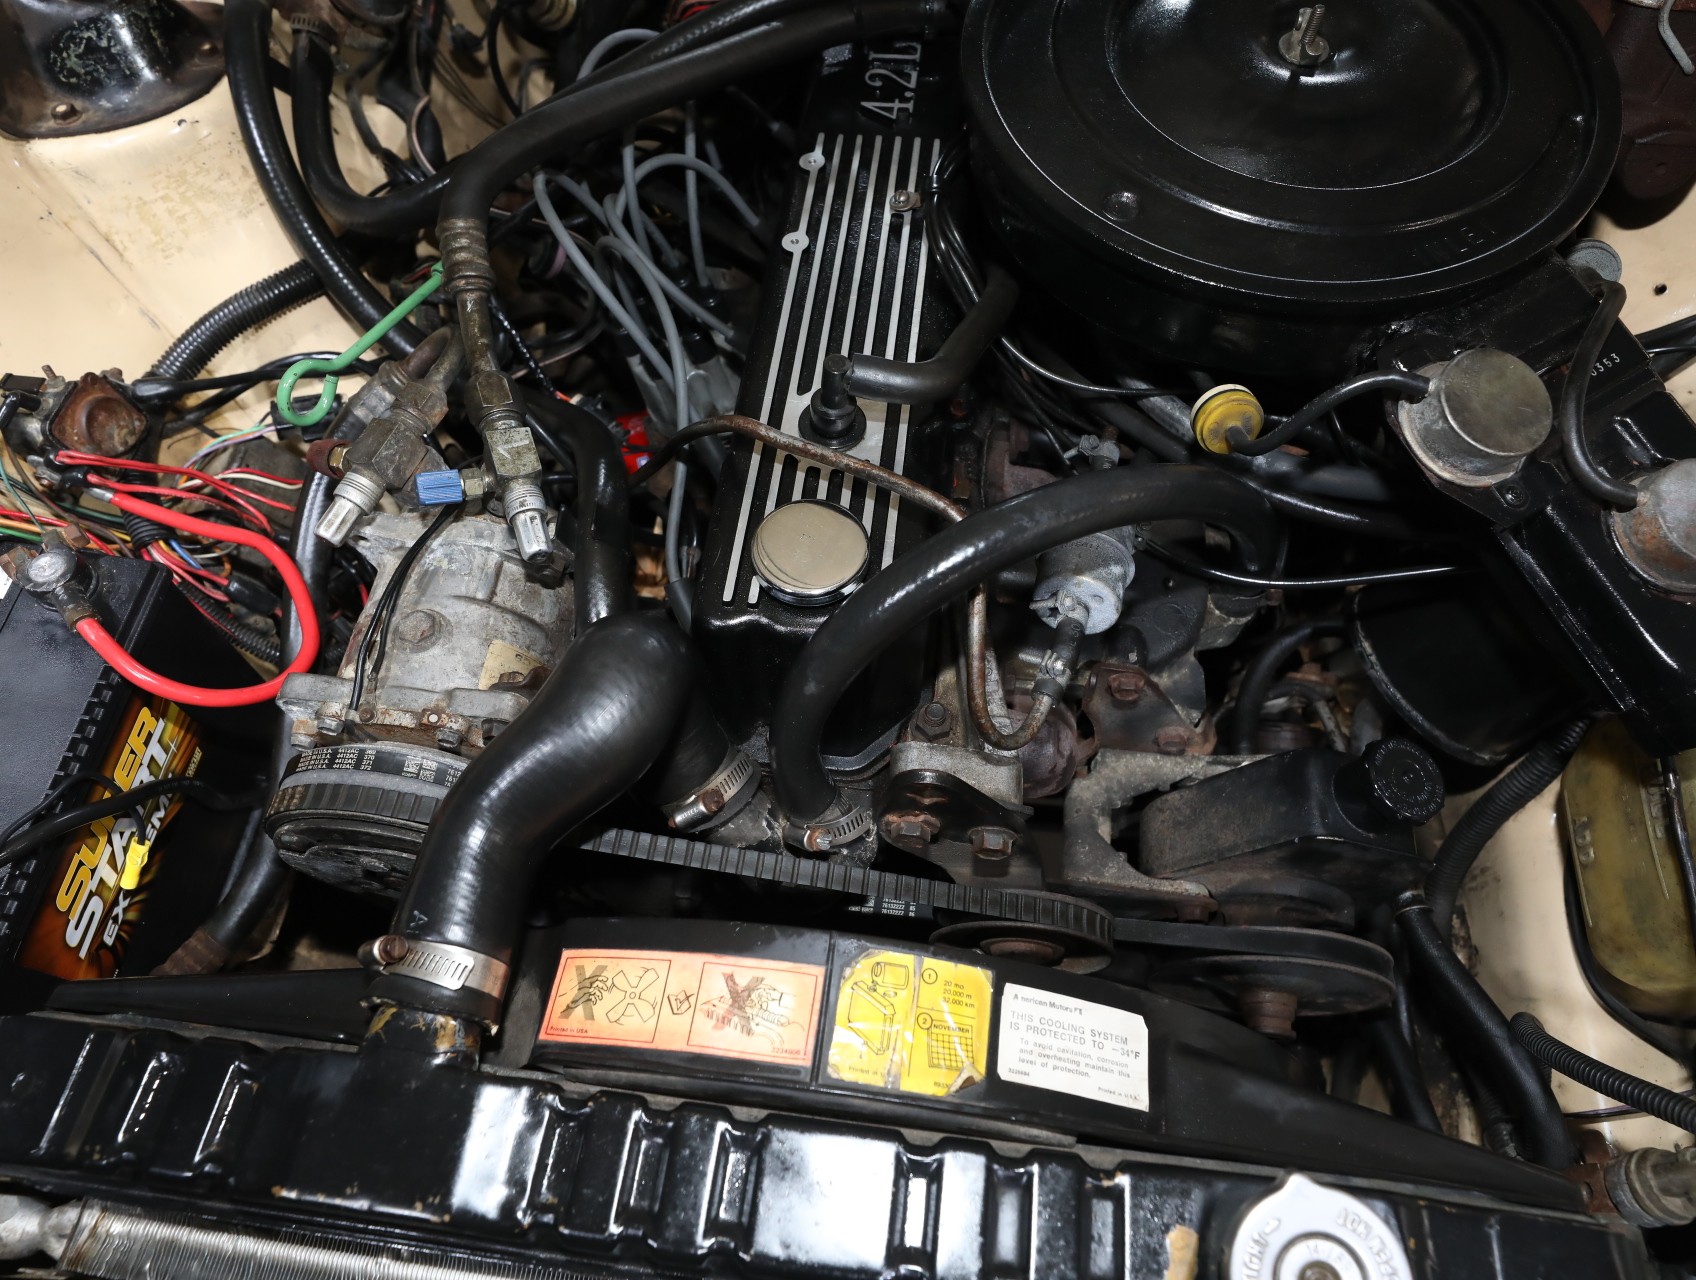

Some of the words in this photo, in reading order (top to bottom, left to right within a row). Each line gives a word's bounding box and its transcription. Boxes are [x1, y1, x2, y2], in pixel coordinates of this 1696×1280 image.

[860, 42, 921, 119] 4.2L
[1010, 1010, 1034, 1023] THIS
[1039, 1017, 1085, 1035] COOLING
[1090, 1029, 1128, 1046] SYSTEM
[1010, 1021, 1020, 1031] IS
[1026, 1024, 1086, 1046] PROTECTED
[1092, 1040, 1104, 1050] TO
[1018, 1056, 1037, 1066] level
[1040, 1060, 1049, 1068] of
[1052, 1064, 1092, 1078] protection.
[1019, 1047, 1034, 1056] and
[1038, 1052, 1081, 1067] overheating
[1084, 1062, 1114, 1075] maintain
[1118, 1070, 1131, 1079] this
[1020, 1037, 1029, 1046] To
[1033, 1041, 1053, 1050] avoid
[1096, 1056, 1129, 1069] corrosion
